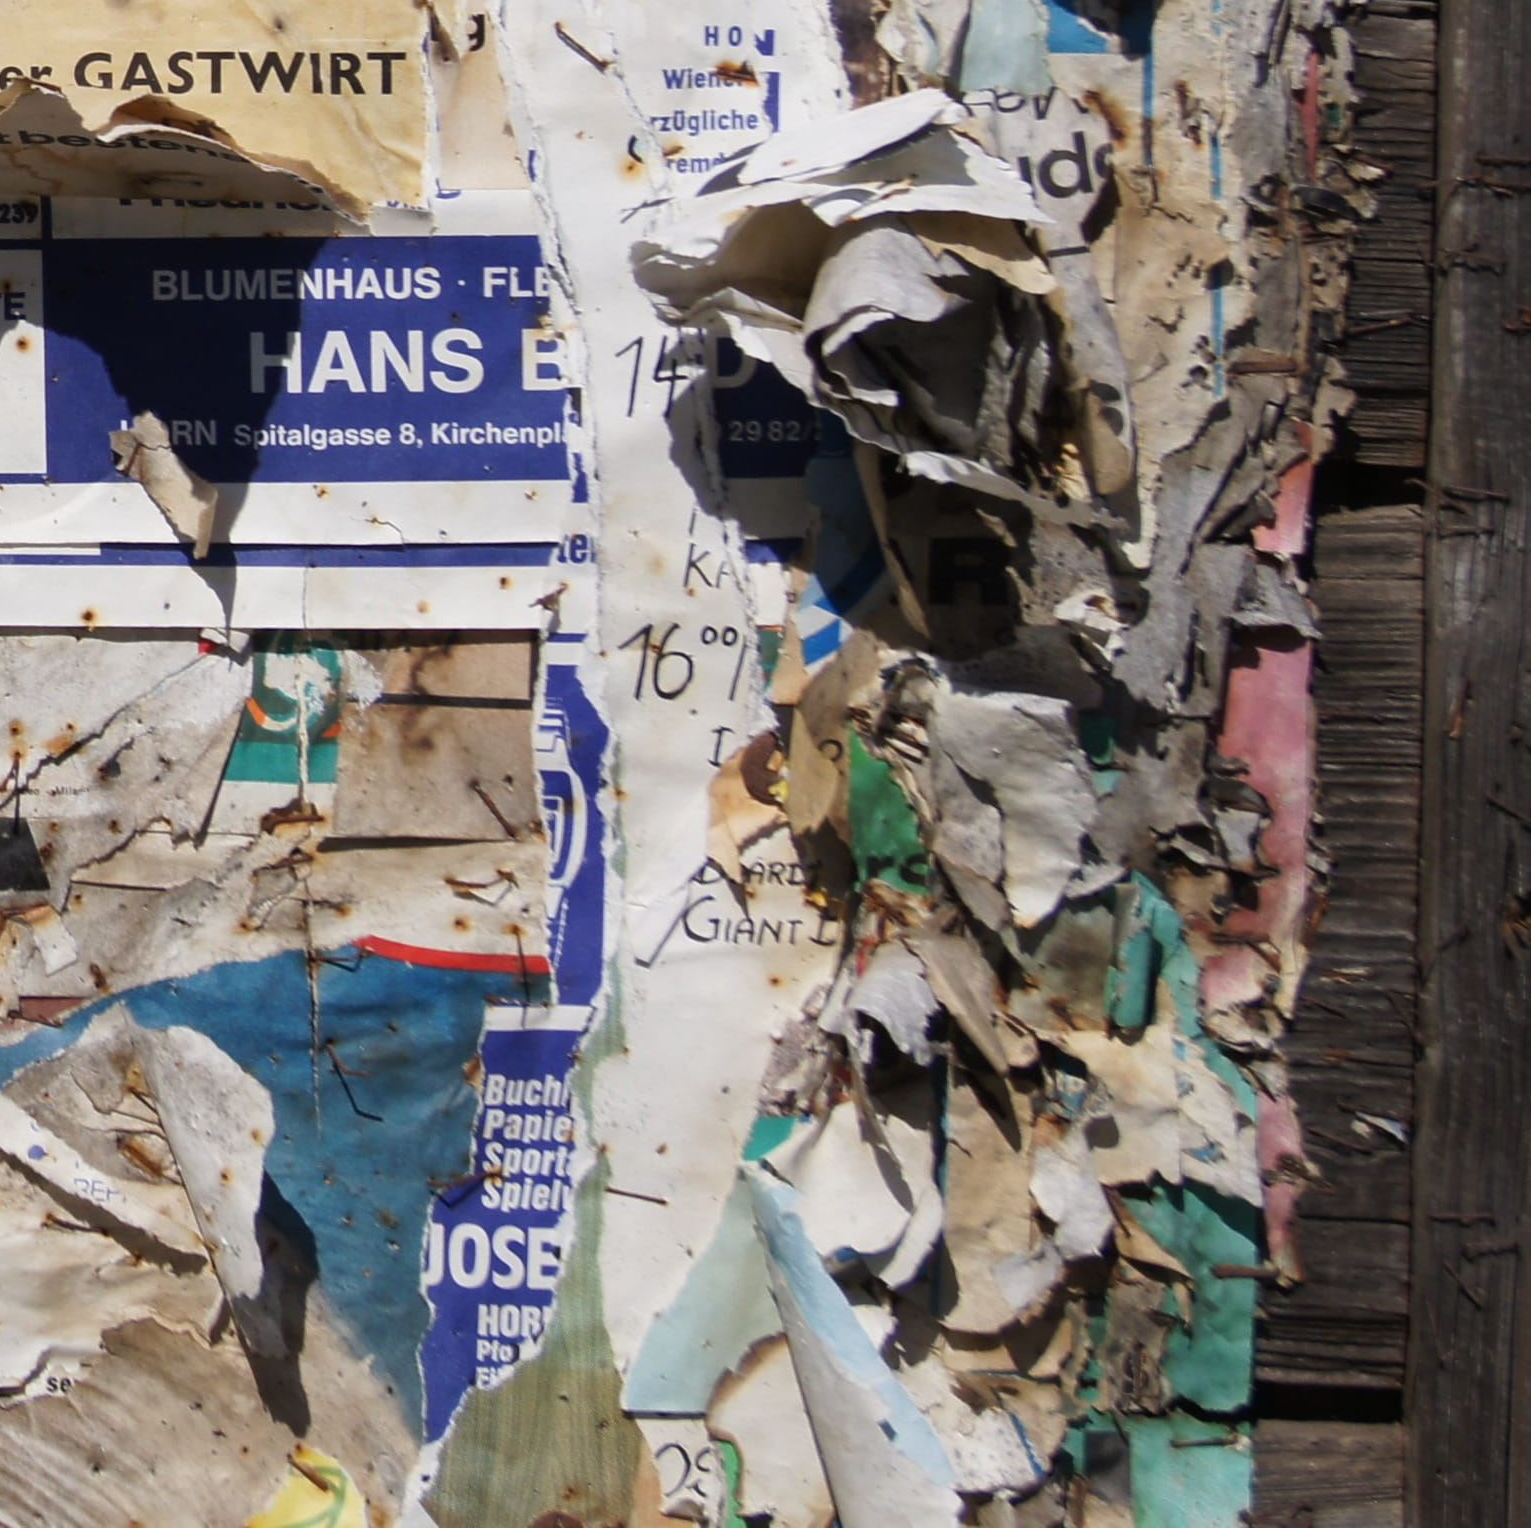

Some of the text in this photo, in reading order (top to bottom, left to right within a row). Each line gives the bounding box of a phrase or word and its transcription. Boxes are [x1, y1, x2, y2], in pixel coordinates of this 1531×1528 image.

[75, 50, 408, 97] GASTWIRT
[152, 267, 442, 301] BLUMENHAUS
[249, 328, 485, 394] HANS
[120, 419, 217, 447] RN
[232, 421, 392, 450] Spitalgasse
[399, 423, 424, 448] 8,
[425, 1222, 561, 1290] JOSE
